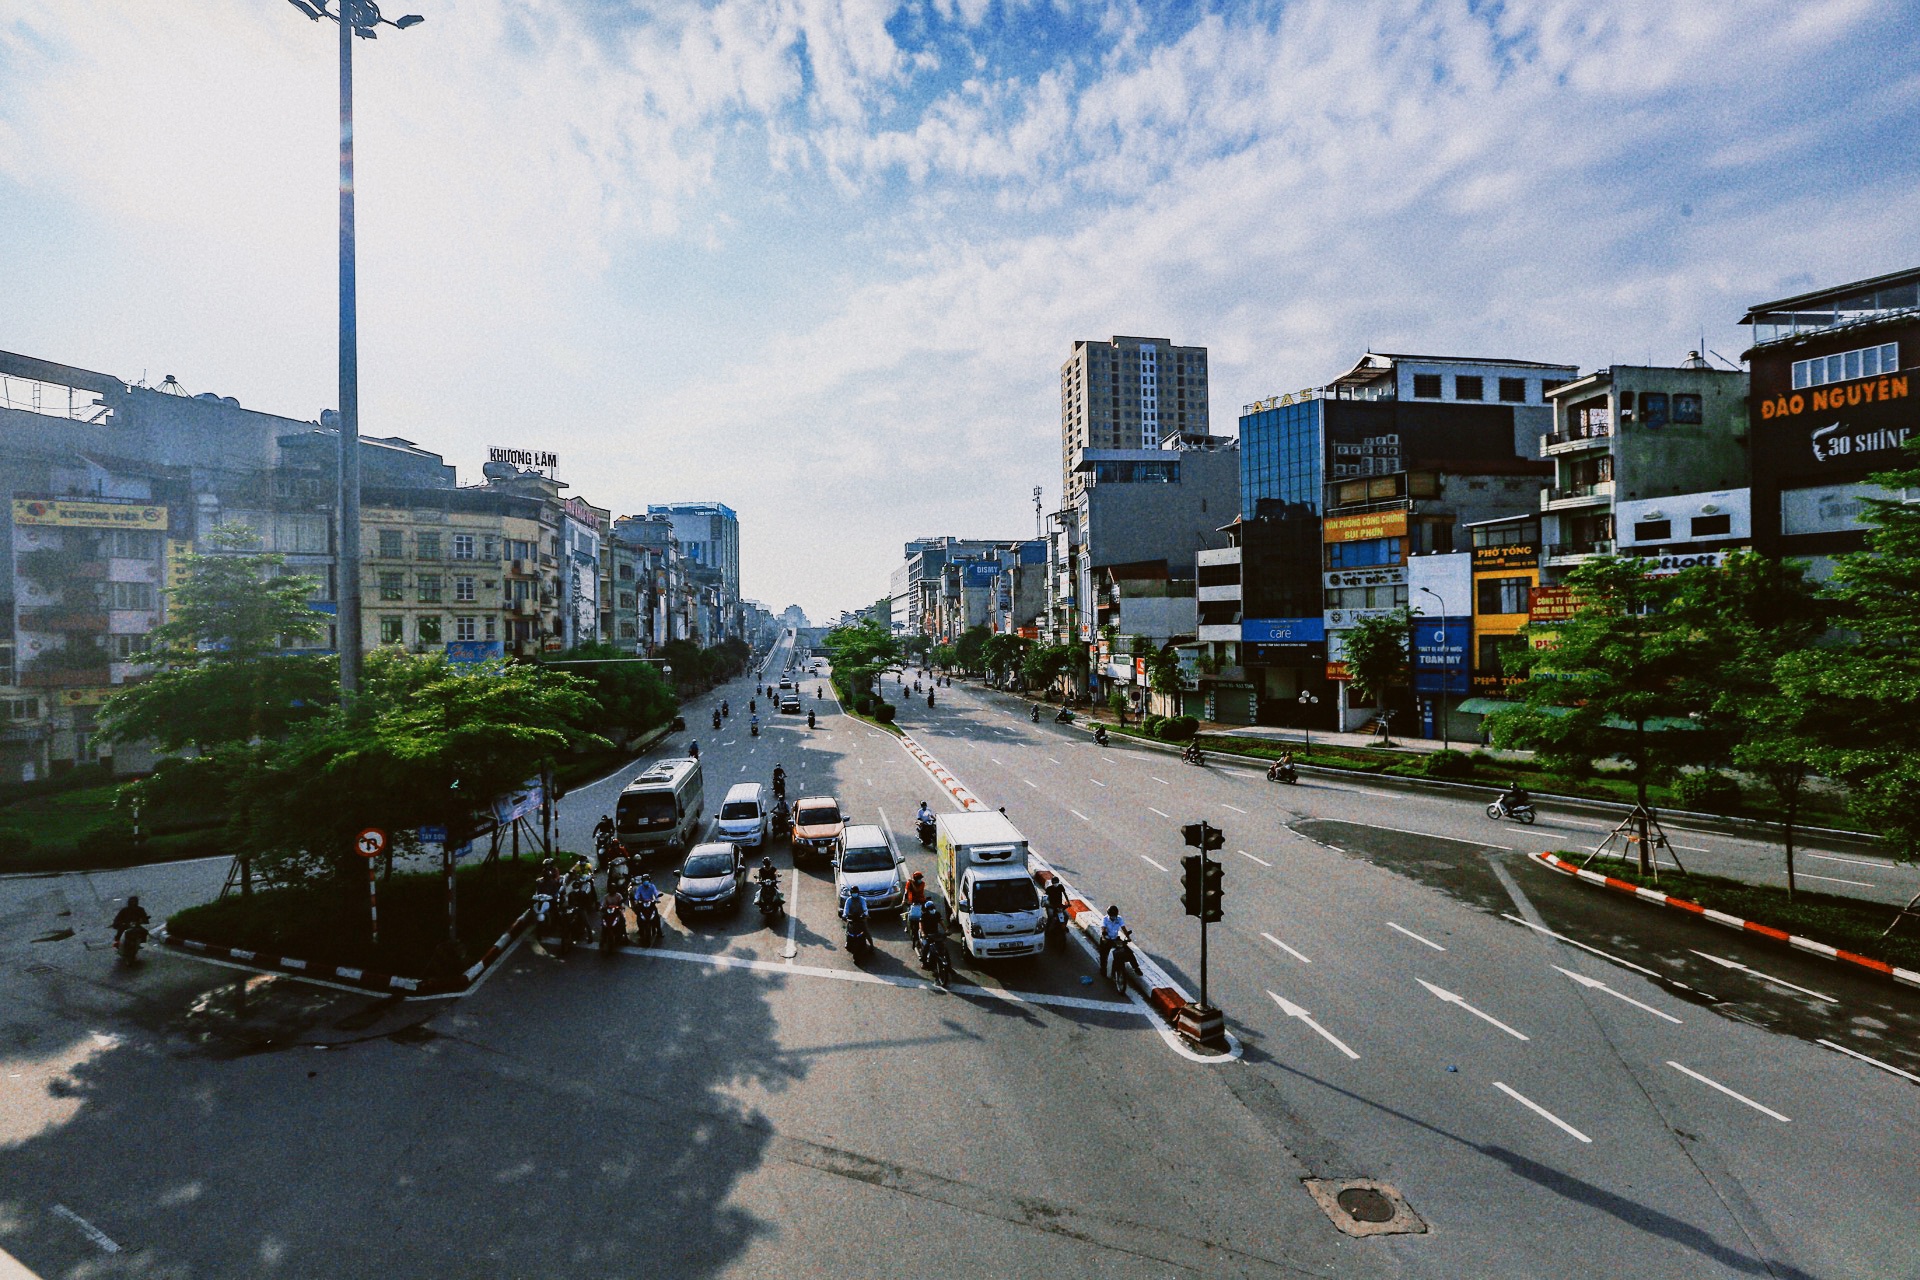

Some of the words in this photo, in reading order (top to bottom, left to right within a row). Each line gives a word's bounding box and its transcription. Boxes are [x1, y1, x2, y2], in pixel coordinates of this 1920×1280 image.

[1761, 393, 1805, 420] ĐÀO
[1813, 376, 1909, 412] NGUYÊN
[1828, 435, 1851, 456] 30
[490, 447, 532, 466] KHƯƠNG
[535, 451, 557, 468] LÂM
[1339, 517, 1361, 529] PHÒNG
[1362, 515, 1380, 526] CÔNG
[1381, 512, 1405, 524] CHỨNG
[1269, 629, 1292, 639] care
